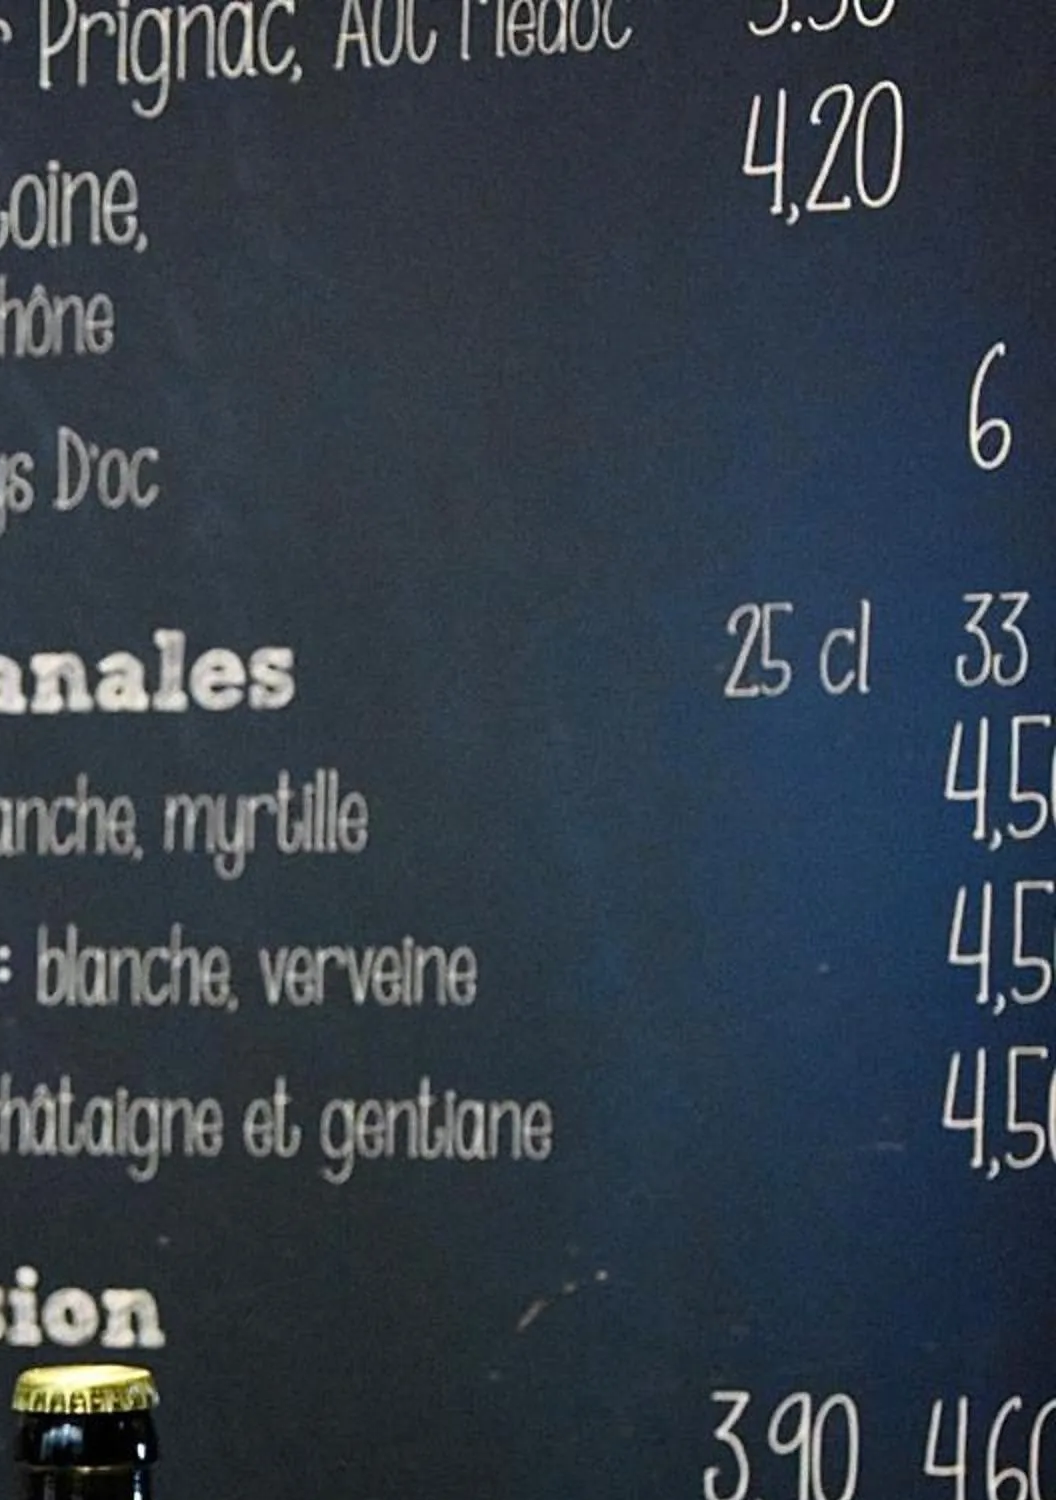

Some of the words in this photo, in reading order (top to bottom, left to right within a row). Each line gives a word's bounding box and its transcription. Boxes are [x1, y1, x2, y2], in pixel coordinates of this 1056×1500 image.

[39, 0, 302, 118] Prignac,
[743, 81, 903, 224] 4,20
[969, 343, 1011, 469] 6
[724, 602, 793, 697] 25
[820, 599, 870, 694] cl
[956, 592, 1029, 686] 33
[164, 768, 368, 879] myrtille
[945, 715, 1056, 850] 4,5
[37, 923, 238, 1011] blanche,
[259, 936, 477, 1005] verveine
[948, 881, 1054, 1014] 4,5
[243, 1076, 301, 1157] et
[321, 1076, 552, 1184] gentiane
